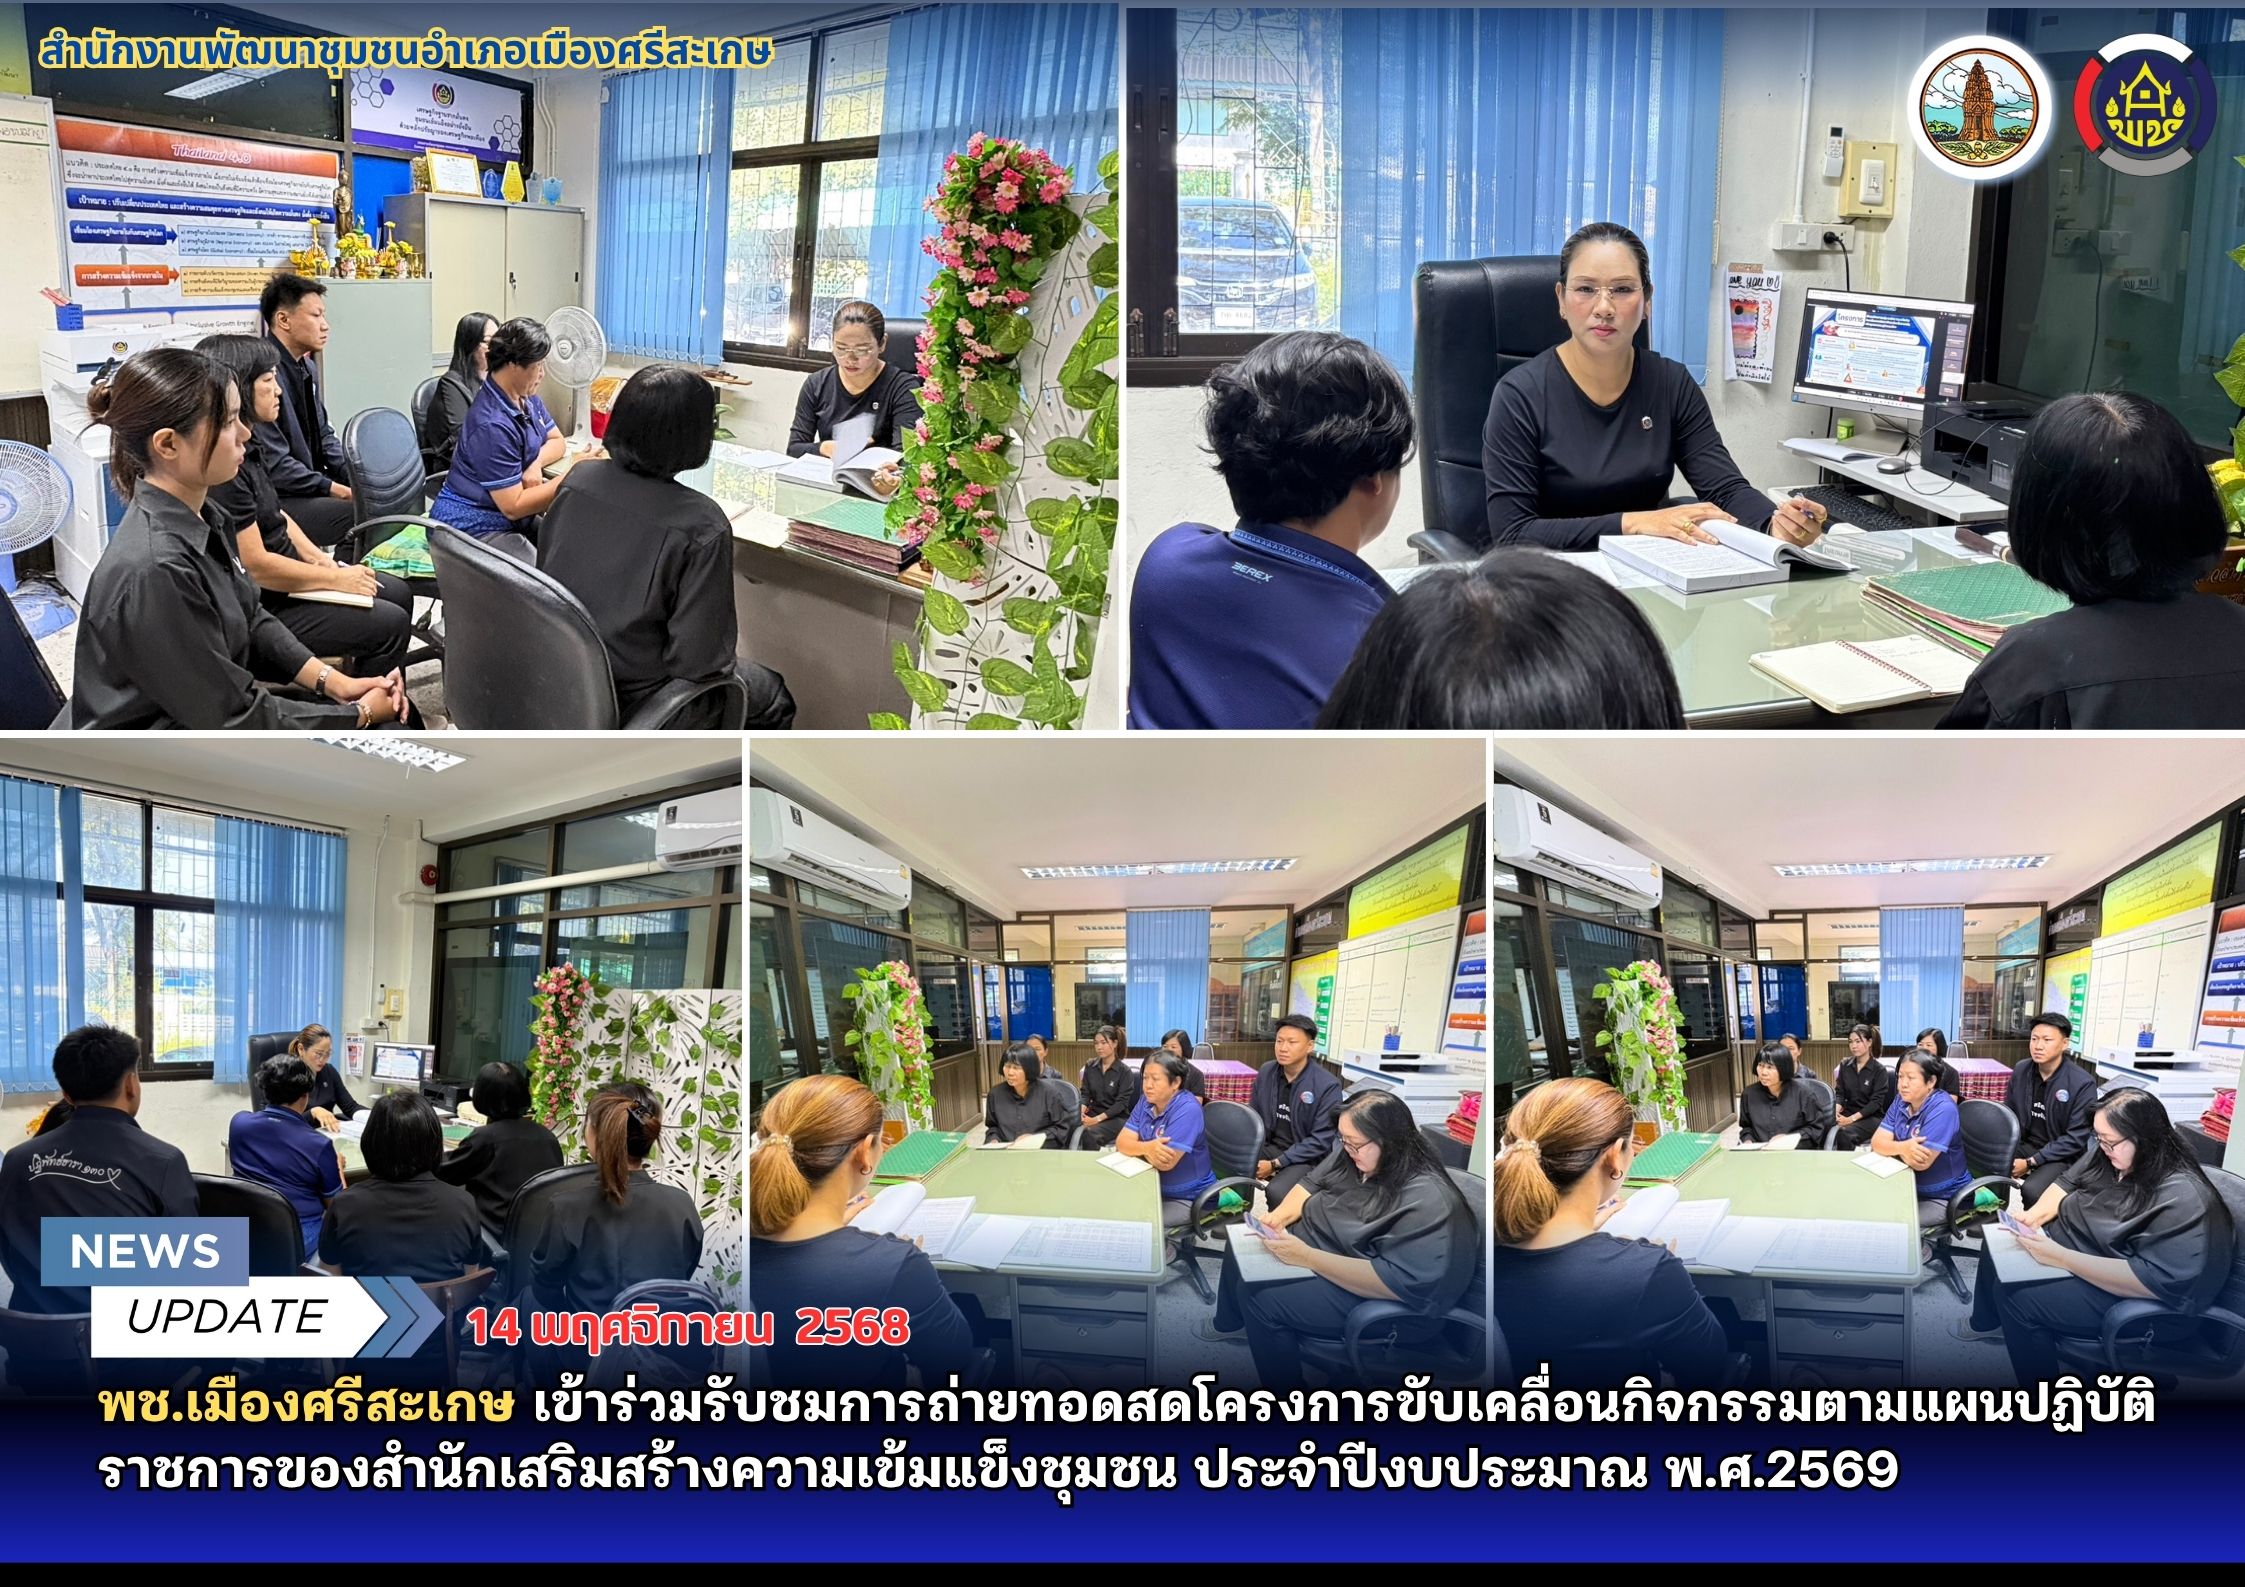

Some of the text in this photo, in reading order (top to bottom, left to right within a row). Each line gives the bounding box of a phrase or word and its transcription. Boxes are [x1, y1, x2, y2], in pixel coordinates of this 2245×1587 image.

[171, 144, 252, 164] Thailand 4.0
[78, 194, 107, 206] เป้าหมาย
